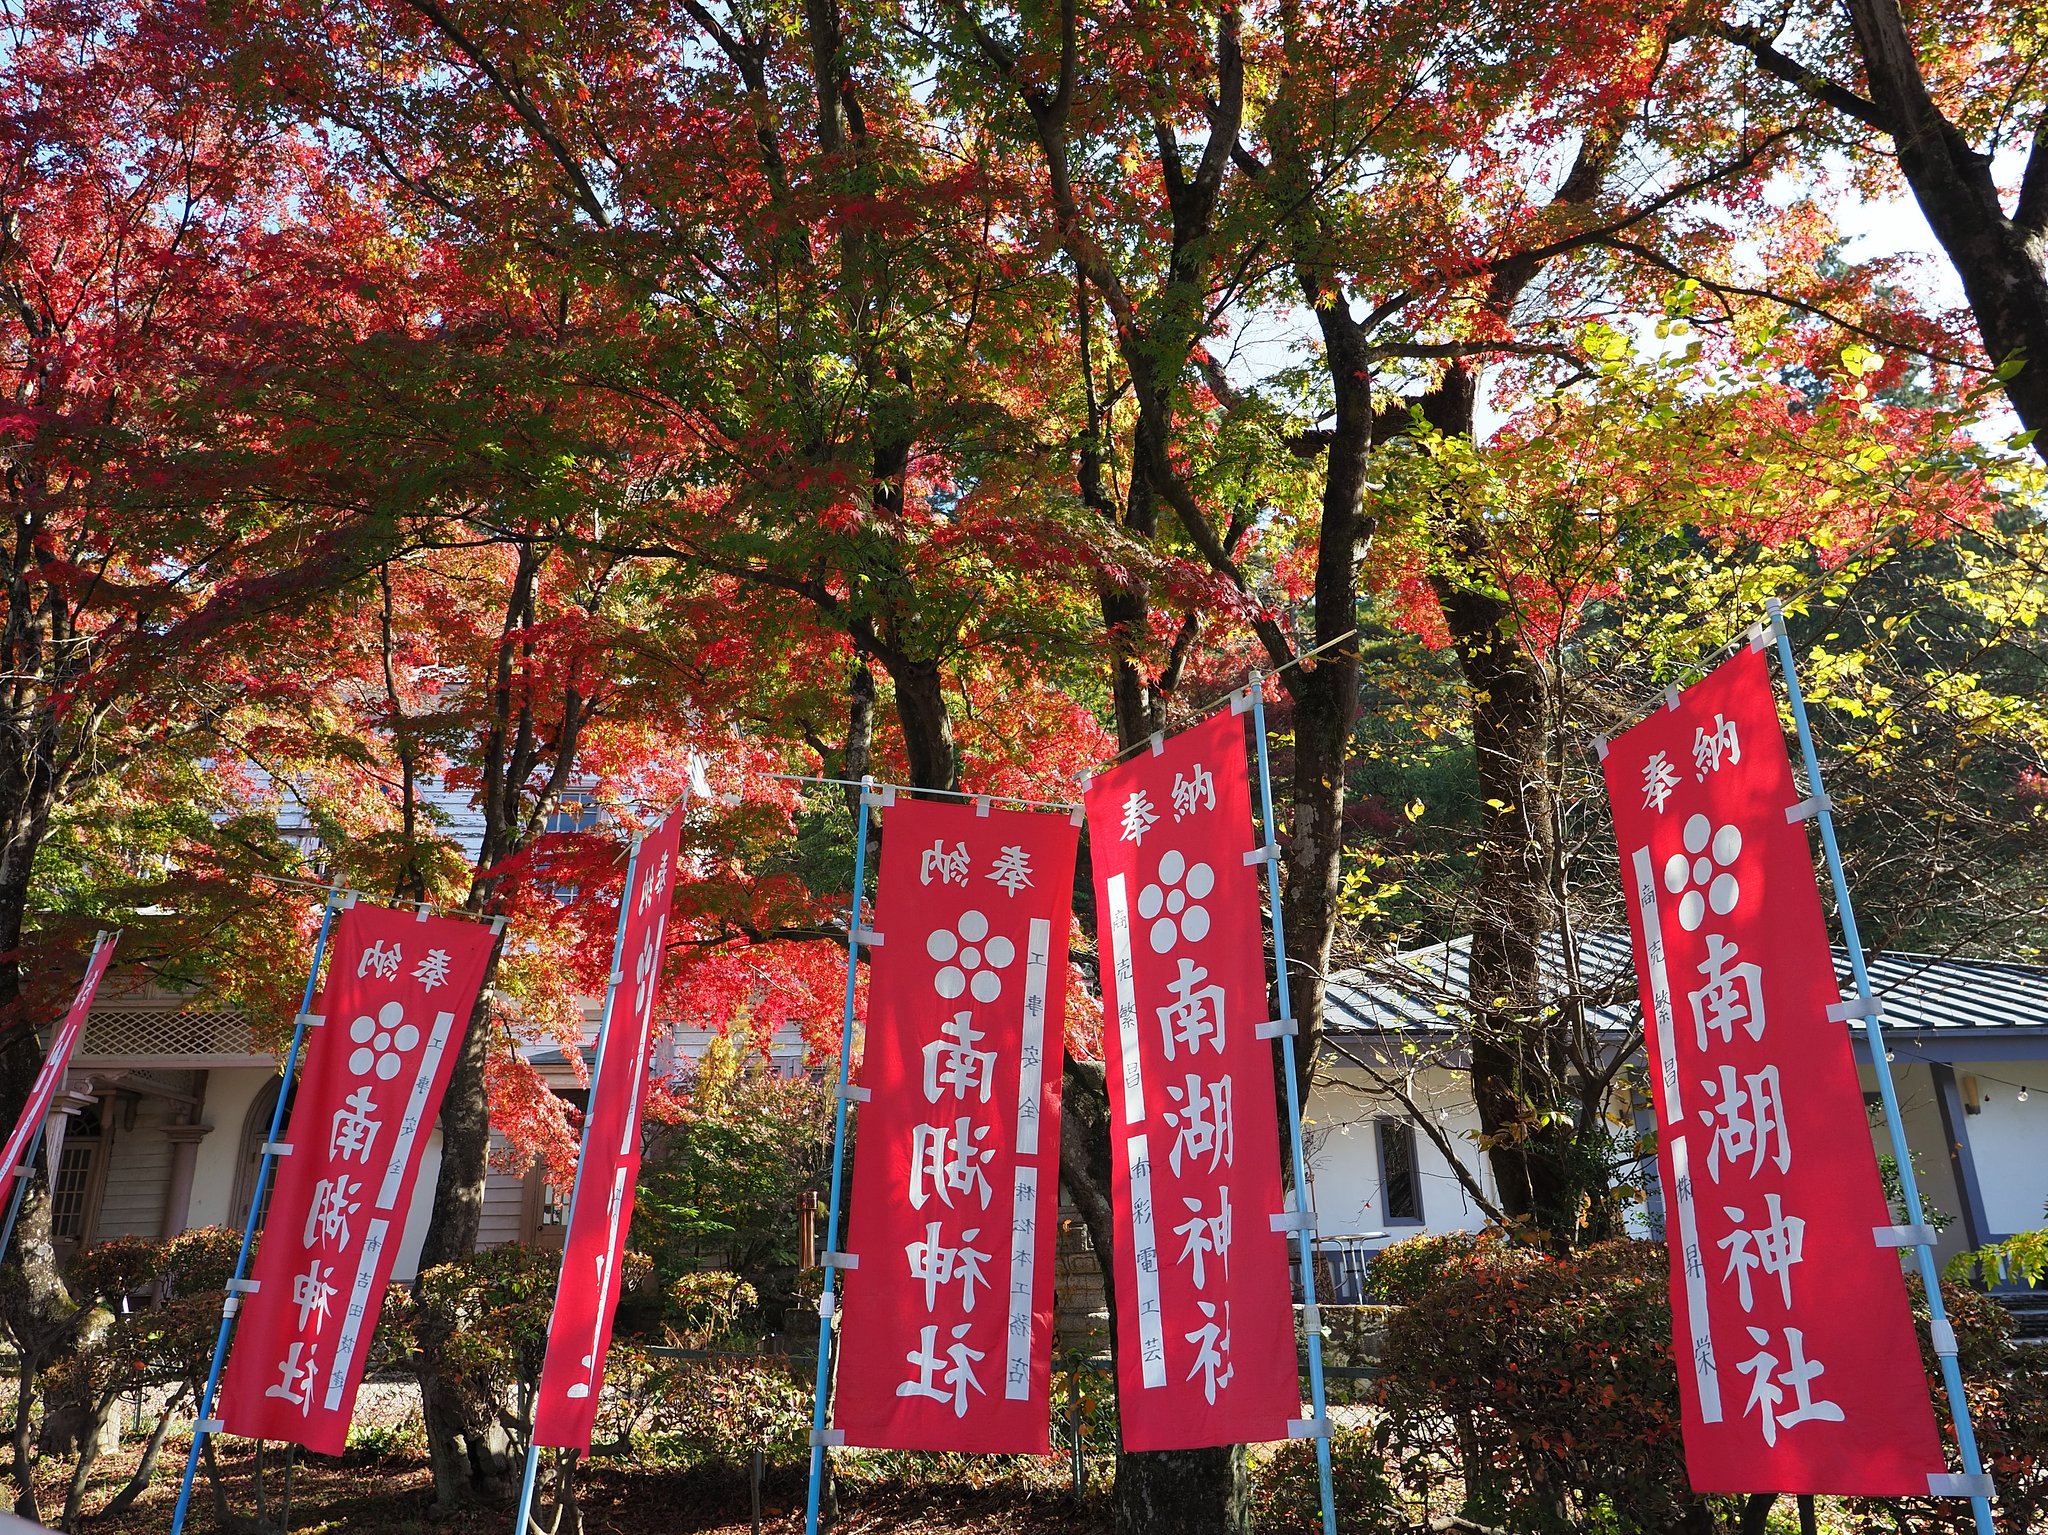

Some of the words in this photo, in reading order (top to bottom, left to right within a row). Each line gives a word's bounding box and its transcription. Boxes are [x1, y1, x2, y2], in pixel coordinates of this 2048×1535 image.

[1120, 764, 1216, 848] 奉納
[1641, 714, 1741, 815] 奉納
[1112, 909, 1140, 1089] 商売繁昌
[1641, 884, 1677, 1089] 商売繁昌
[1157, 958, 1236, 1406] 南湖神社
[1688, 934, 1846, 1448] 南湖神社
